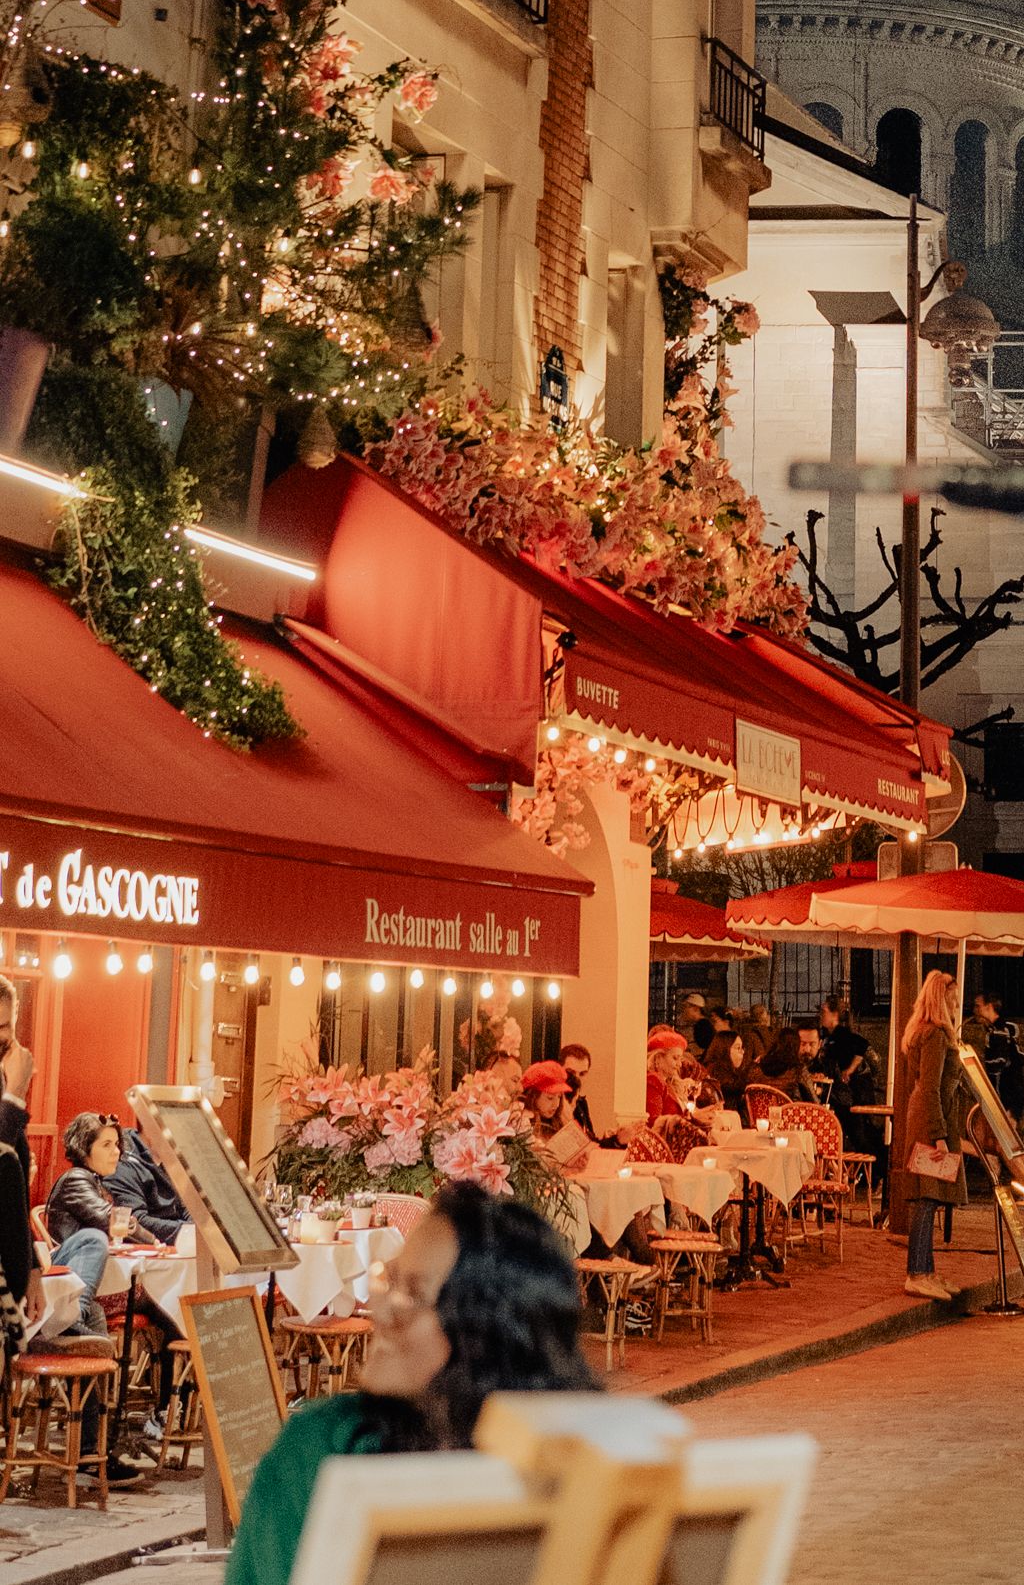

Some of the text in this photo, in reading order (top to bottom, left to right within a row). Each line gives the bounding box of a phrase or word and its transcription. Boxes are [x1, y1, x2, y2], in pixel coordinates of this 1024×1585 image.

[576, 676, 619, 710] BUVETTE
[877, 778, 919, 805] RESTAURANT
[16, 863, 52, 908] de
[58, 848, 200, 925] GASCOGNE
[365, 898, 541, 957] Restaurant salle au 1er
